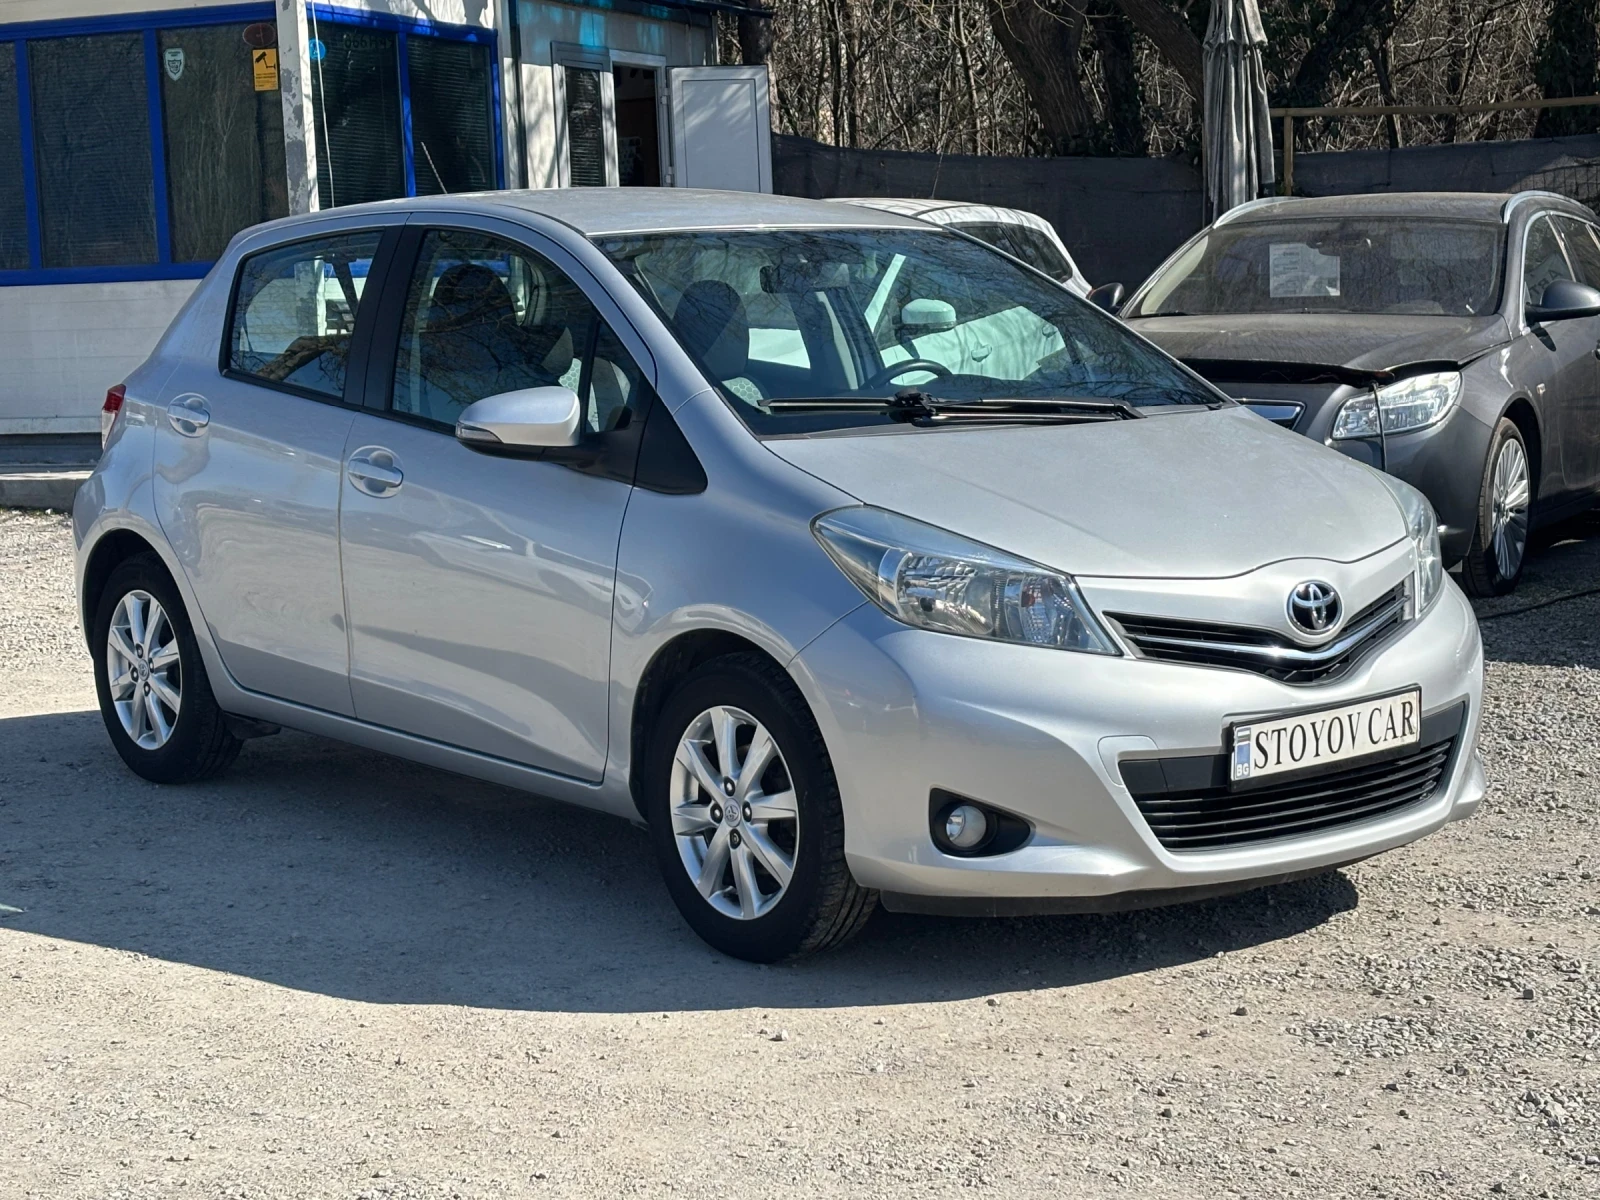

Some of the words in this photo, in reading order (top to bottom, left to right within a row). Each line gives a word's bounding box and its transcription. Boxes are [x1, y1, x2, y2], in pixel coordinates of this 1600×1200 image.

[1254, 711, 1361, 769] STOYOV
[1368, 700, 1415, 745] CAR
[1236, 763, 1250, 777] BG
